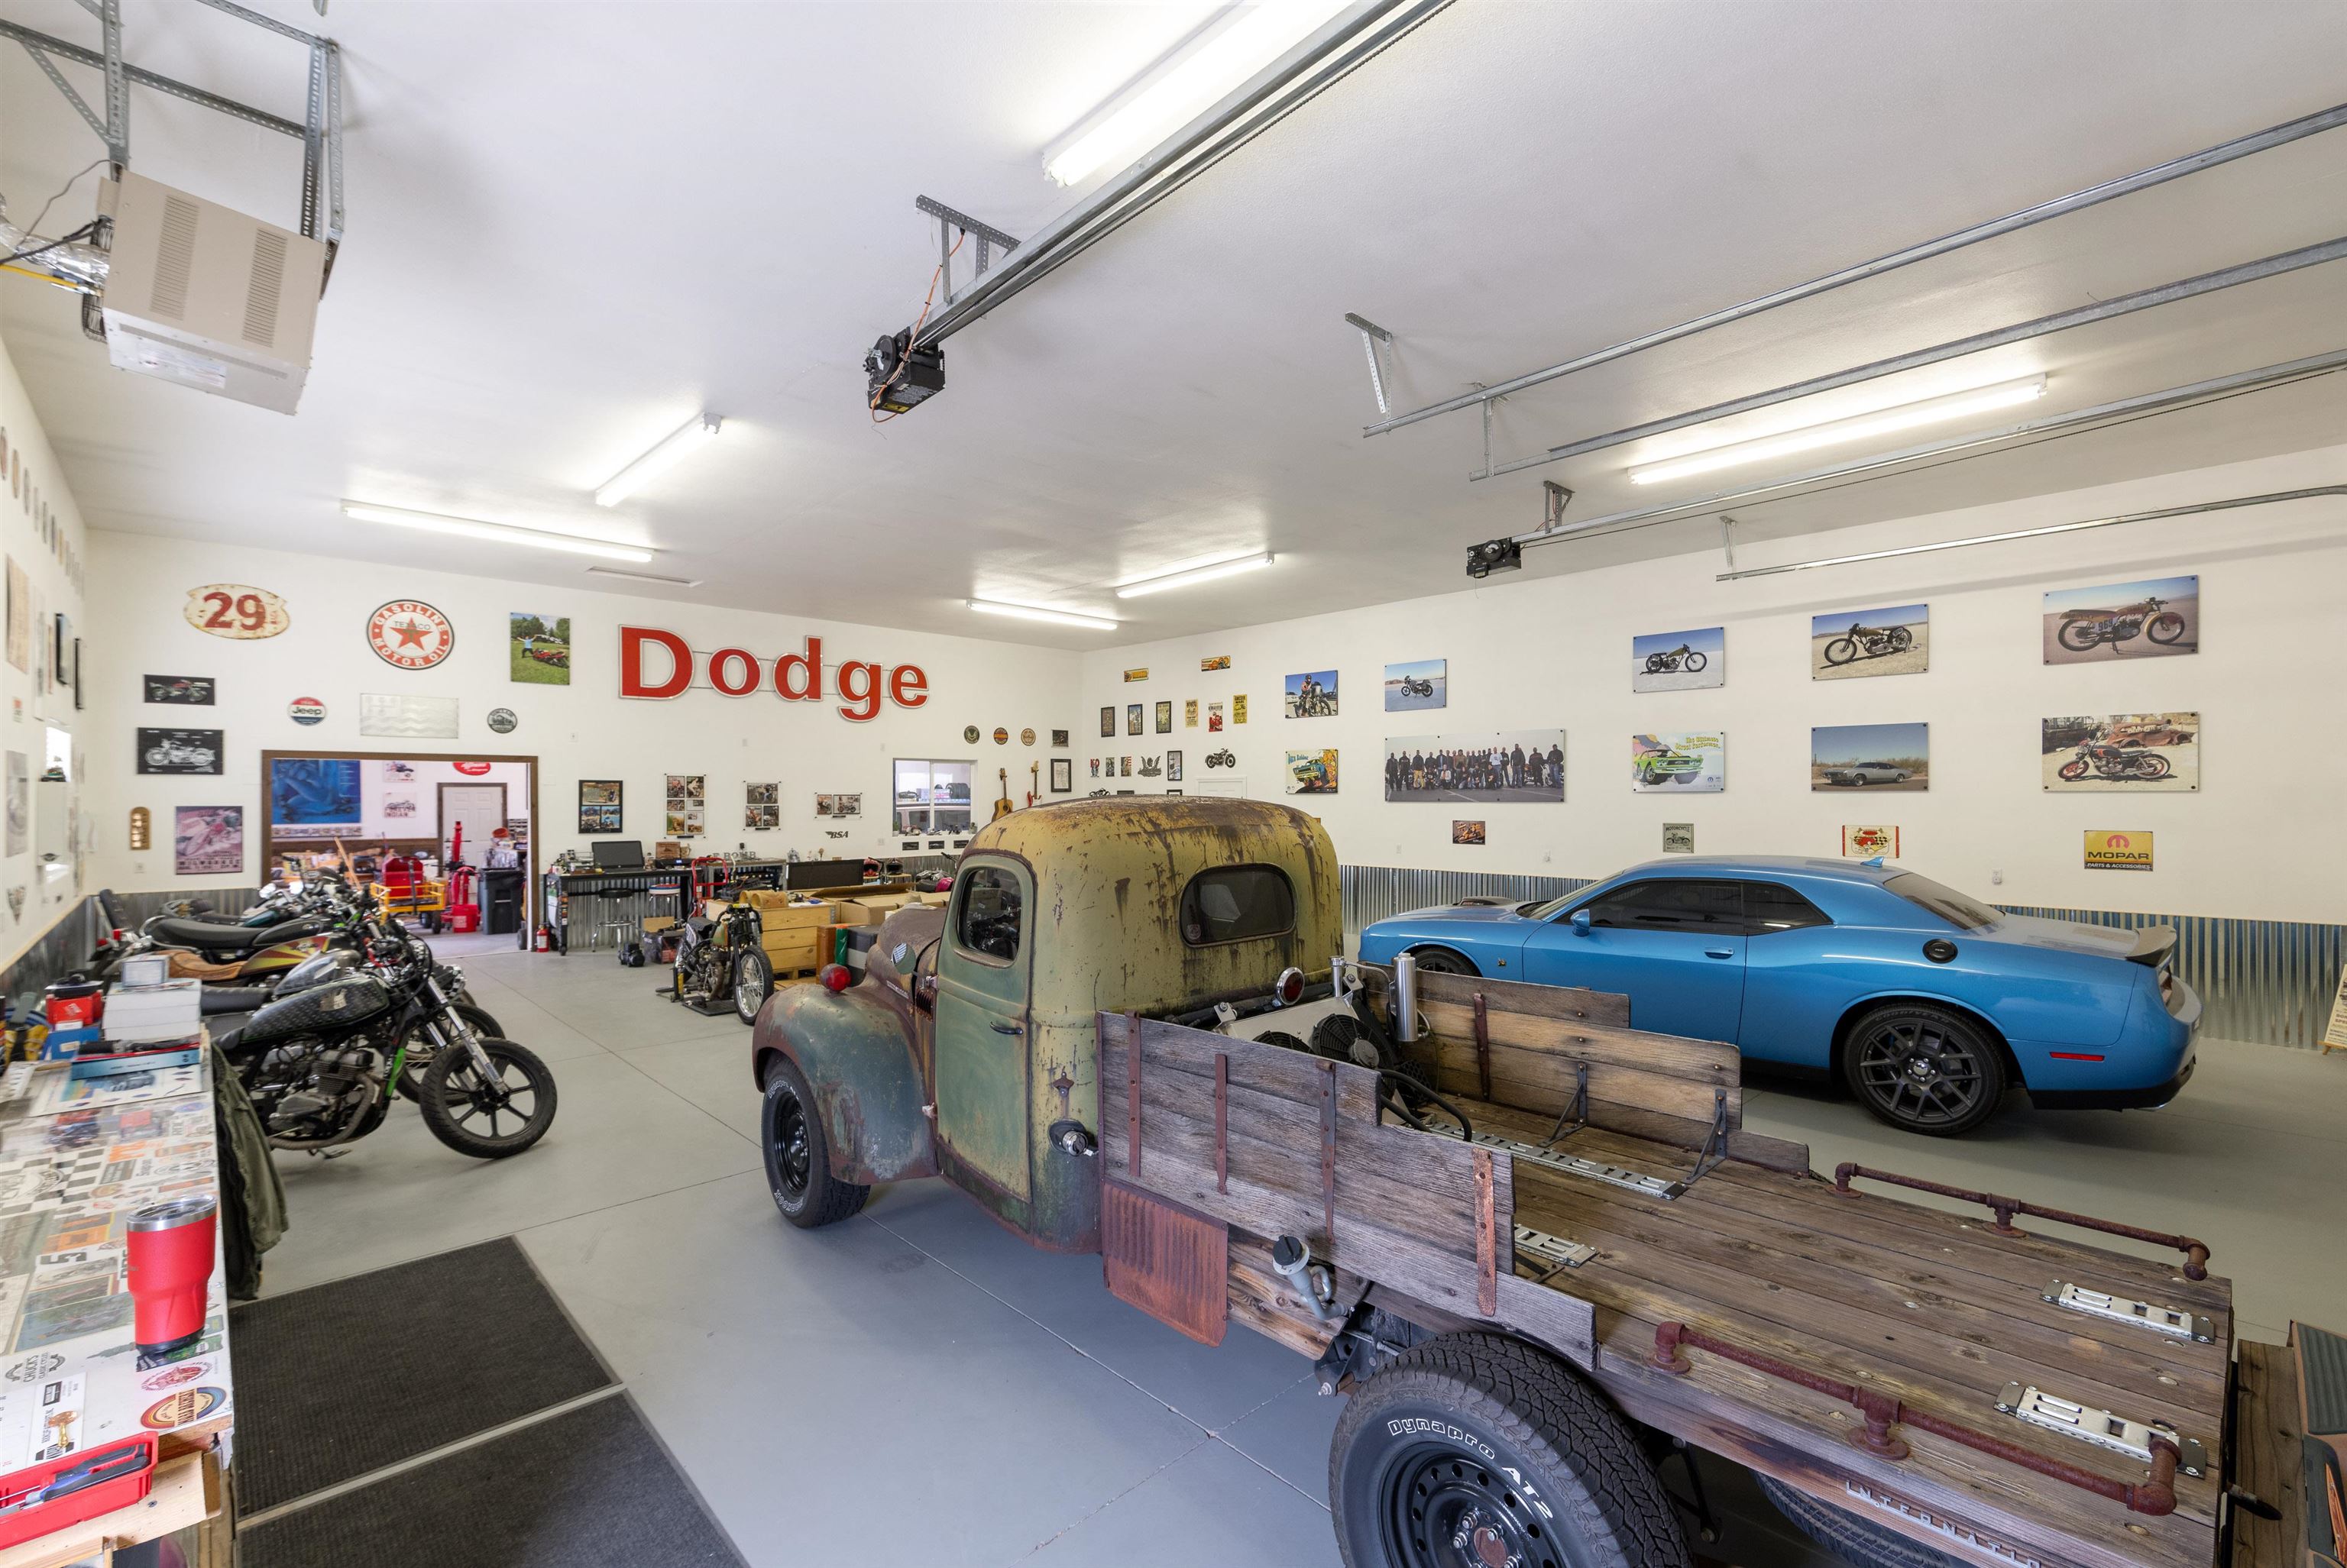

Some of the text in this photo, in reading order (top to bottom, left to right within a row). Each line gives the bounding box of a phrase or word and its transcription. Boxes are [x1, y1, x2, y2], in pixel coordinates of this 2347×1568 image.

[202, 591, 266, 631] 29
[374, 603, 447, 632] GASOLINE
[373, 637, 448, 667] MOTOR OIL
[617, 623, 930, 723] Dodge
[292, 706, 322, 716] Jeep
[723, 851, 757, 862] BOMB
[2087, 851, 2149, 860] MOPAR
[1387, 1418, 1554, 1519] Dynapro AT2
